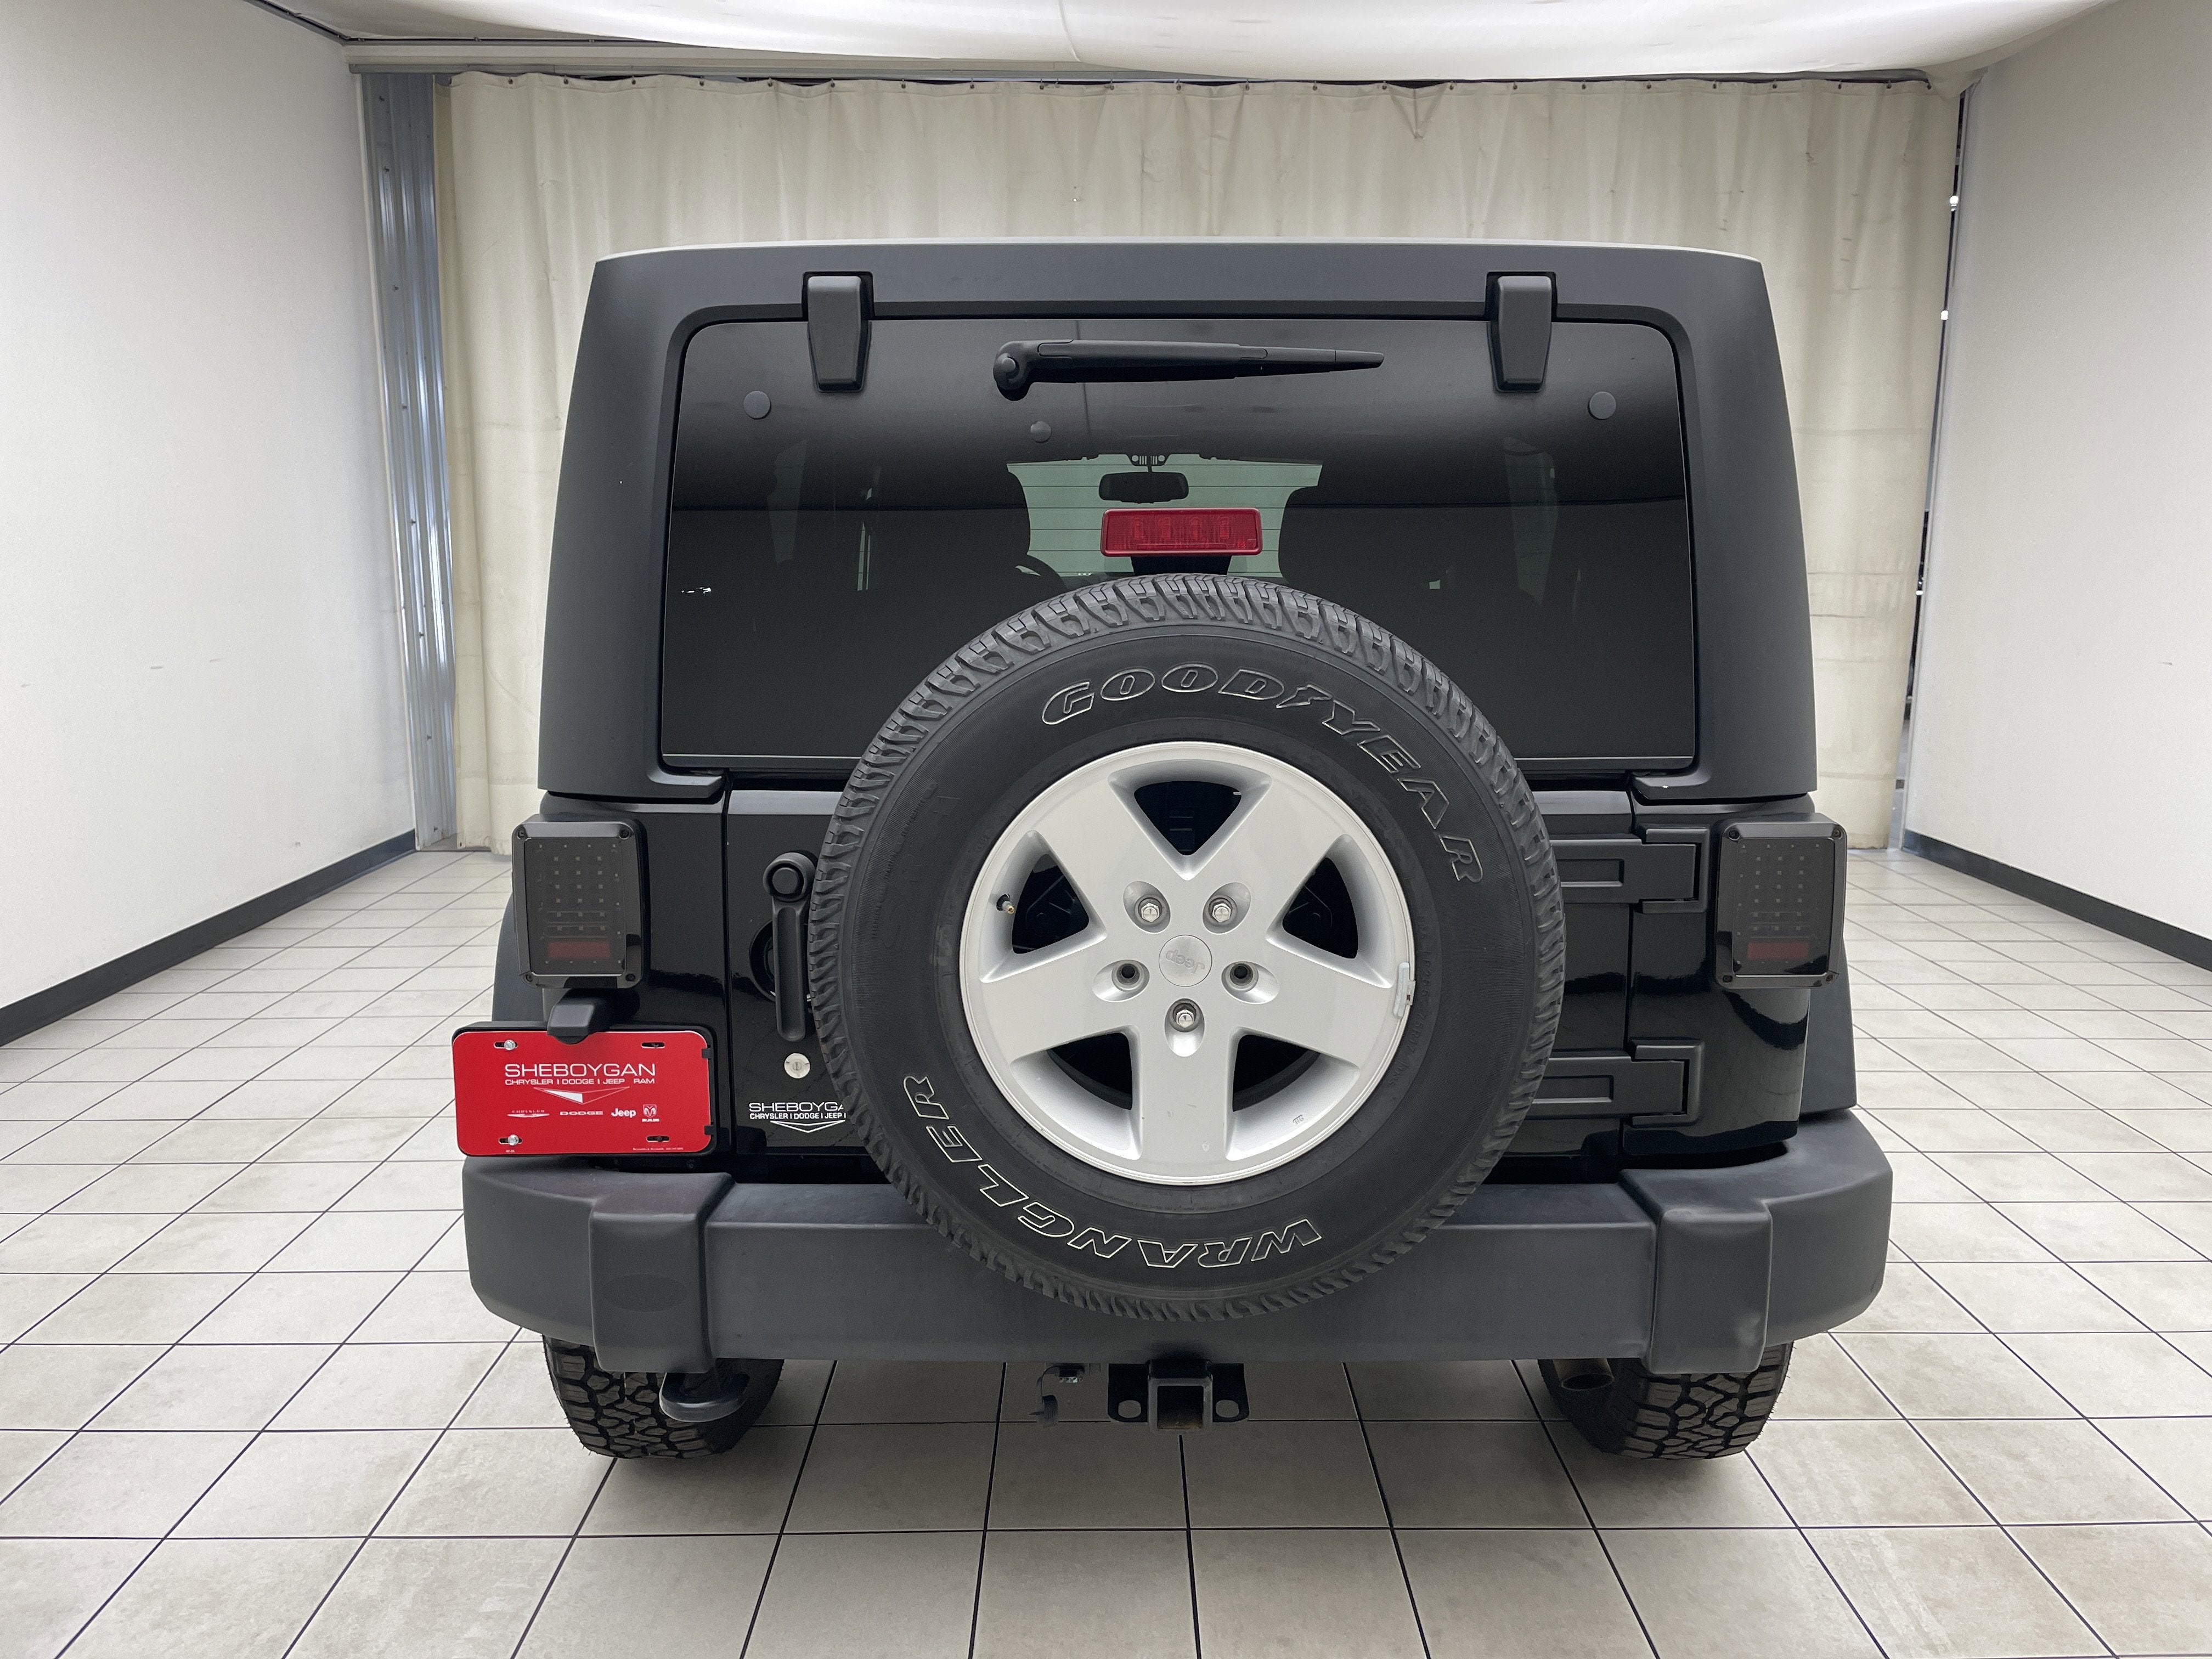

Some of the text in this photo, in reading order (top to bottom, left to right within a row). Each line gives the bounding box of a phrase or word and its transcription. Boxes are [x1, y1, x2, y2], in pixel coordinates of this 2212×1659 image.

[1041, 663, 1483, 883] GOODYEAR
[1165, 949, 1205, 974] Jeep
[504, 1063, 656, 1077] SHEBOYGAN
[611, 1108, 636, 1118] Jeep
[902, 1076, 1322, 1268] WRANGLER
